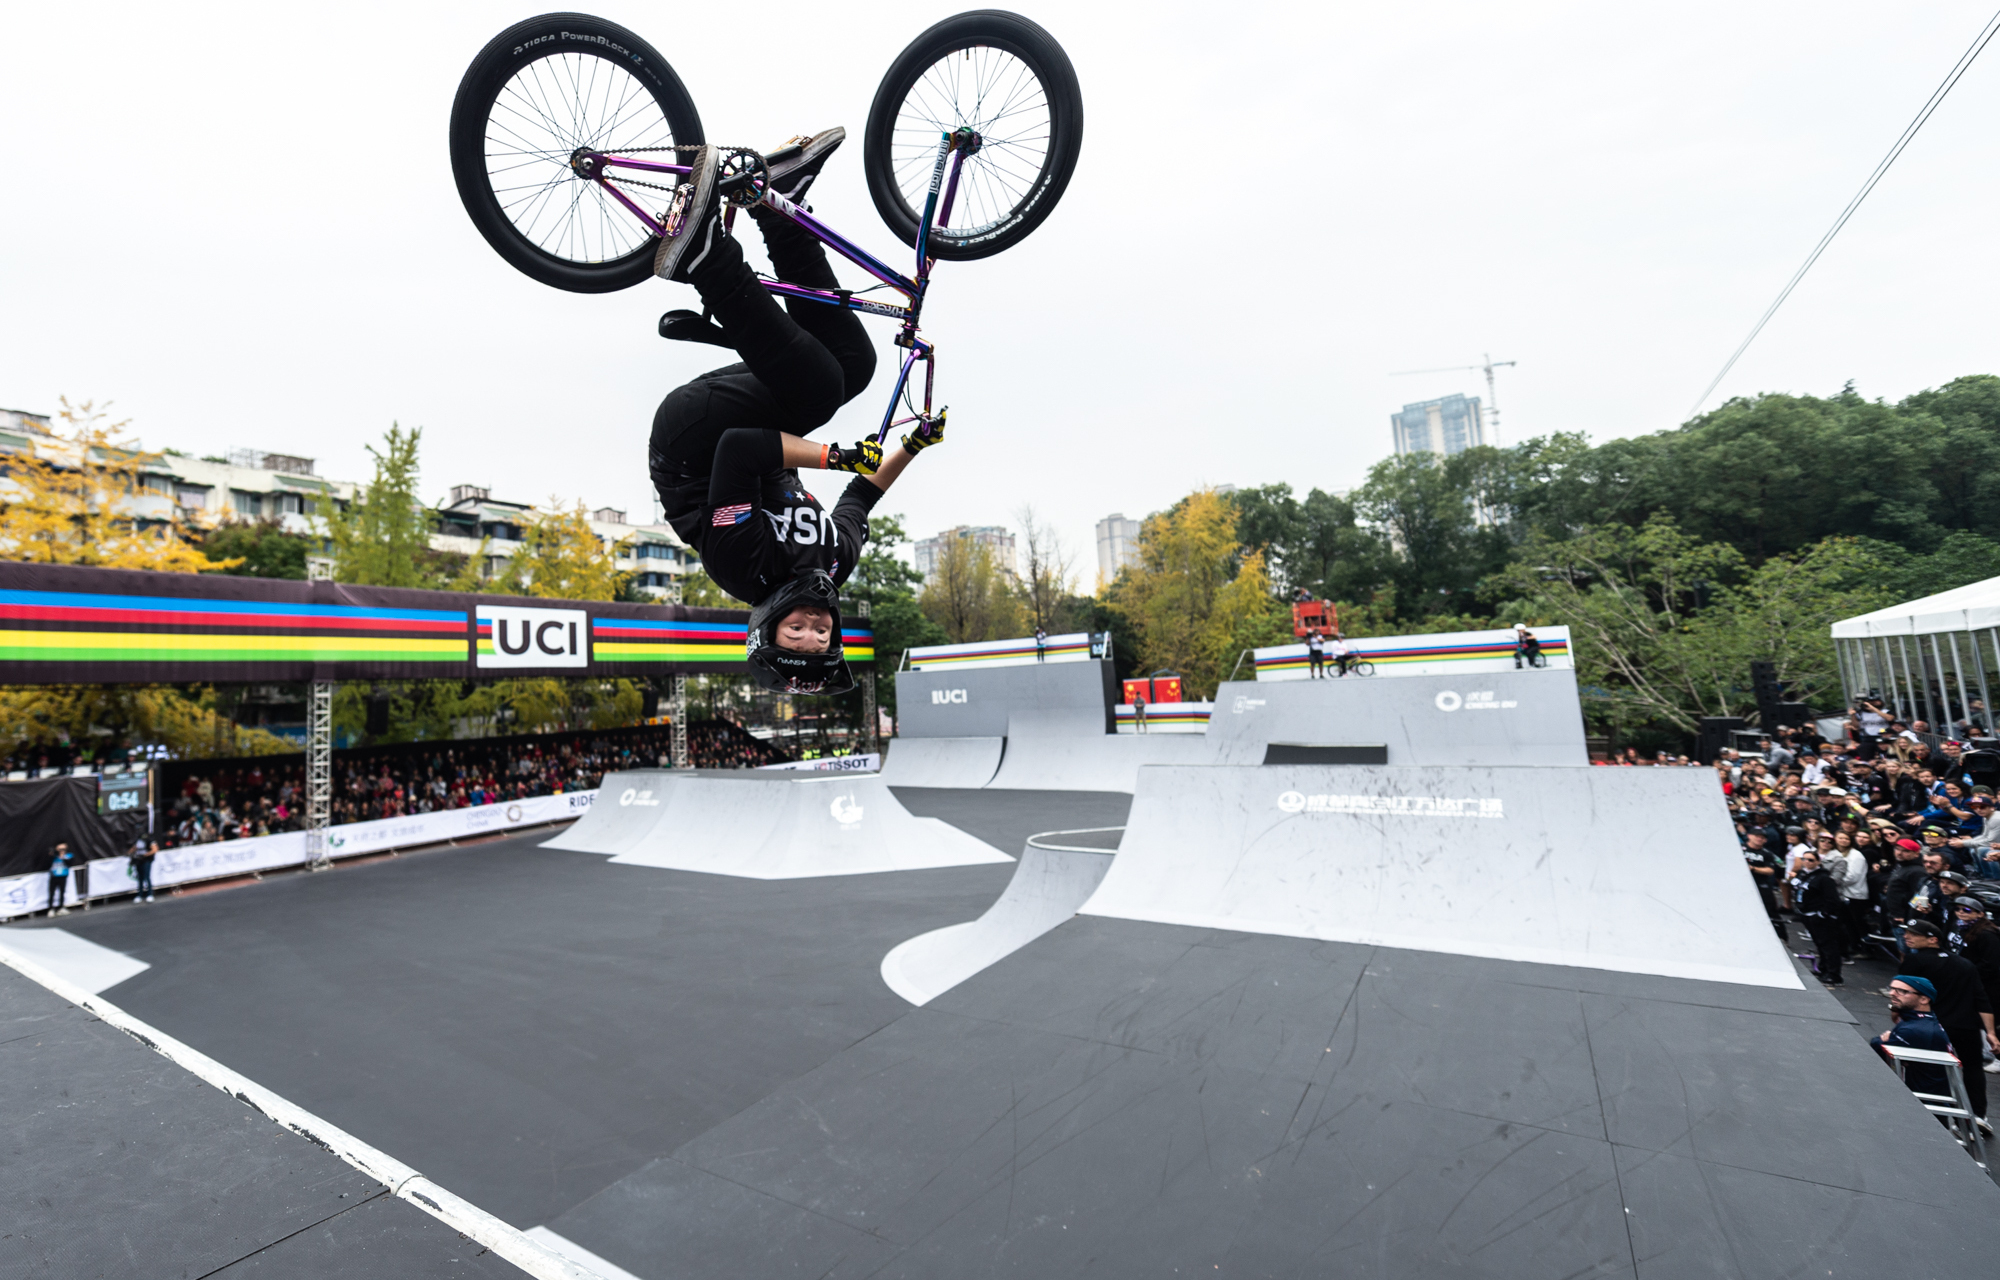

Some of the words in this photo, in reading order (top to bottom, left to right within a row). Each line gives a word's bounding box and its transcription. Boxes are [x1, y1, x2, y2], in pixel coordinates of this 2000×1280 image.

[523, 34, 555, 49] TIOGA
[760, 506, 839, 548] USA
[498, 619, 578, 655] UCI
[828, 757, 870, 770] TISSOT
